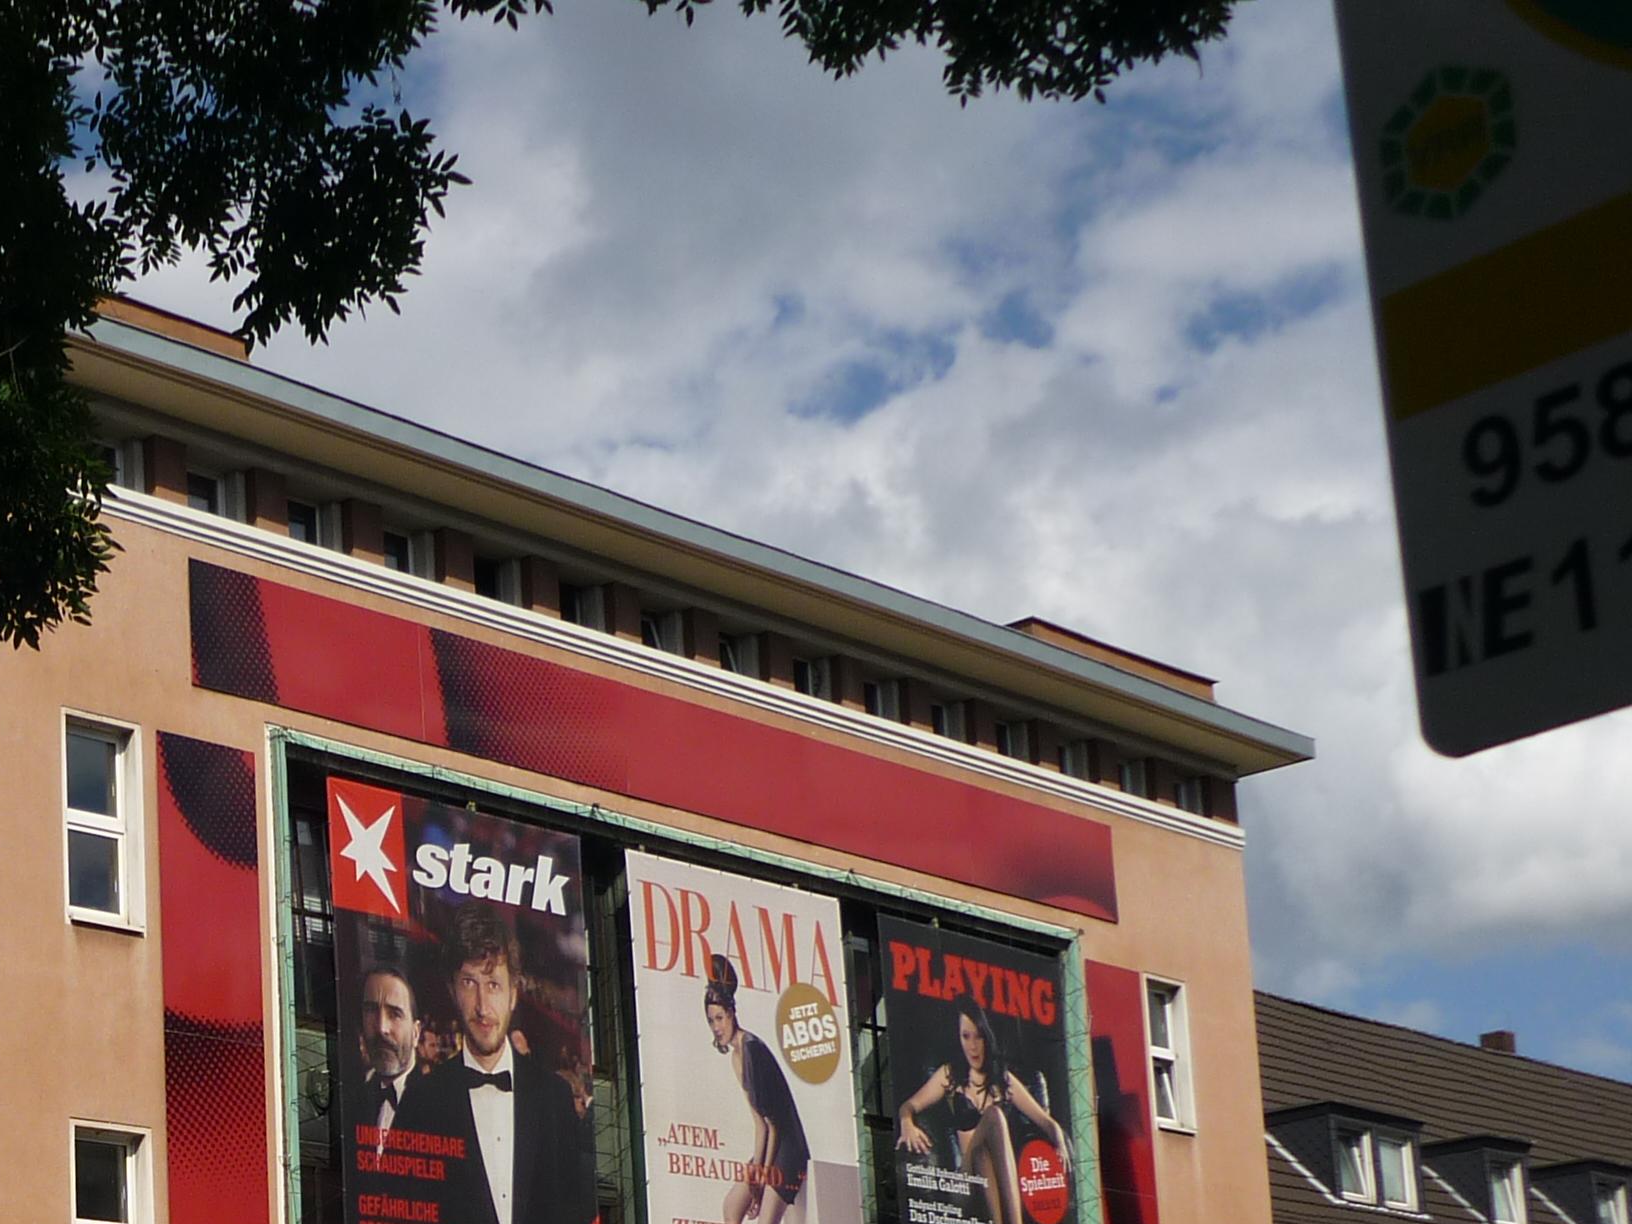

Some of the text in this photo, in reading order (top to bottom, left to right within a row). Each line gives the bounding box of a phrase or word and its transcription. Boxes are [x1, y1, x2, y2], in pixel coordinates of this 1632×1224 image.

[1463, 363, 1632, 508] 958
[413, 843, 570, 916] stark
[636, 879, 842, 1007] DRAMA
[889, 941, 1056, 1026] PLAYING
[789, 1003, 818, 1020] JETZT
[783, 1014, 836, 1048] ABOS
[356, 1124, 465, 1158] UNBERECHENBARE
[357, 1151, 445, 1181] SCHAUSPIELER
[1029, 1157, 1050, 1173] Die
[358, 1193, 440, 1222] GEFÄHRLICHE
